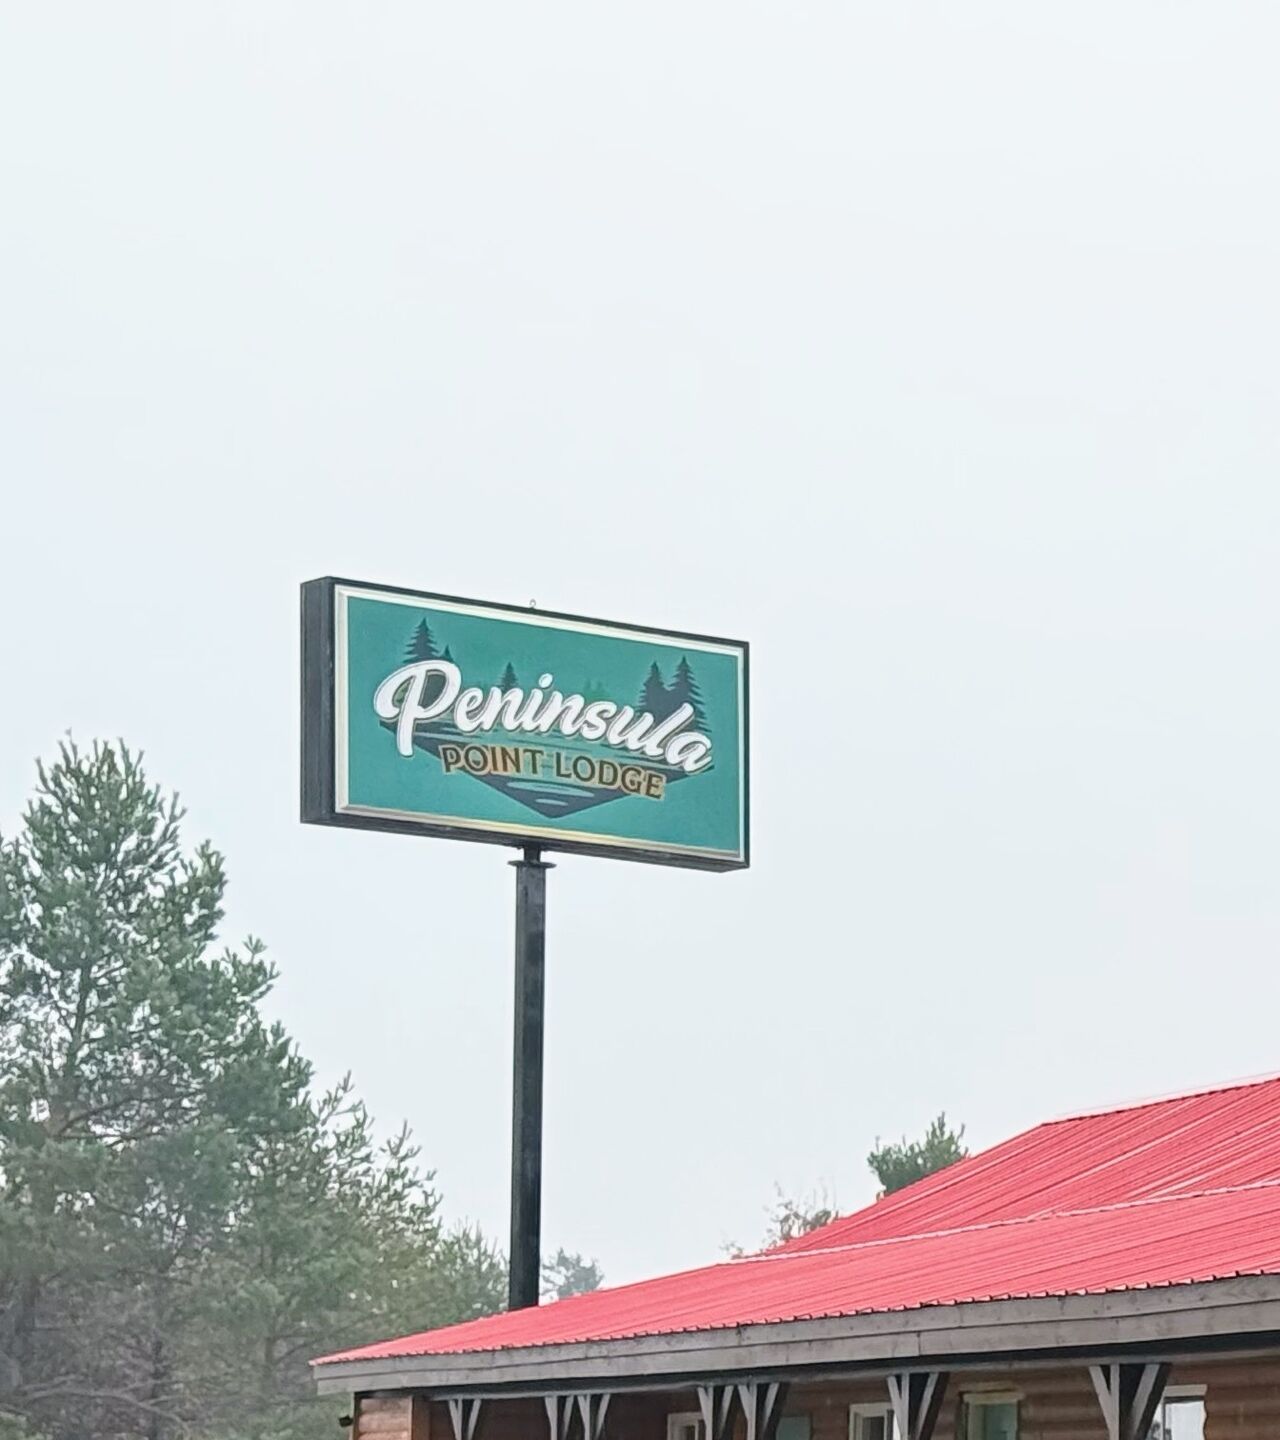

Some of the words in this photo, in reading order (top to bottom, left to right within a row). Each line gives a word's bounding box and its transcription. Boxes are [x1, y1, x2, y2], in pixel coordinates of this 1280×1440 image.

[373, 659, 713, 772] Peninsula
[441, 745, 544, 774] POINT
[555, 751, 665, 800] LODGE
